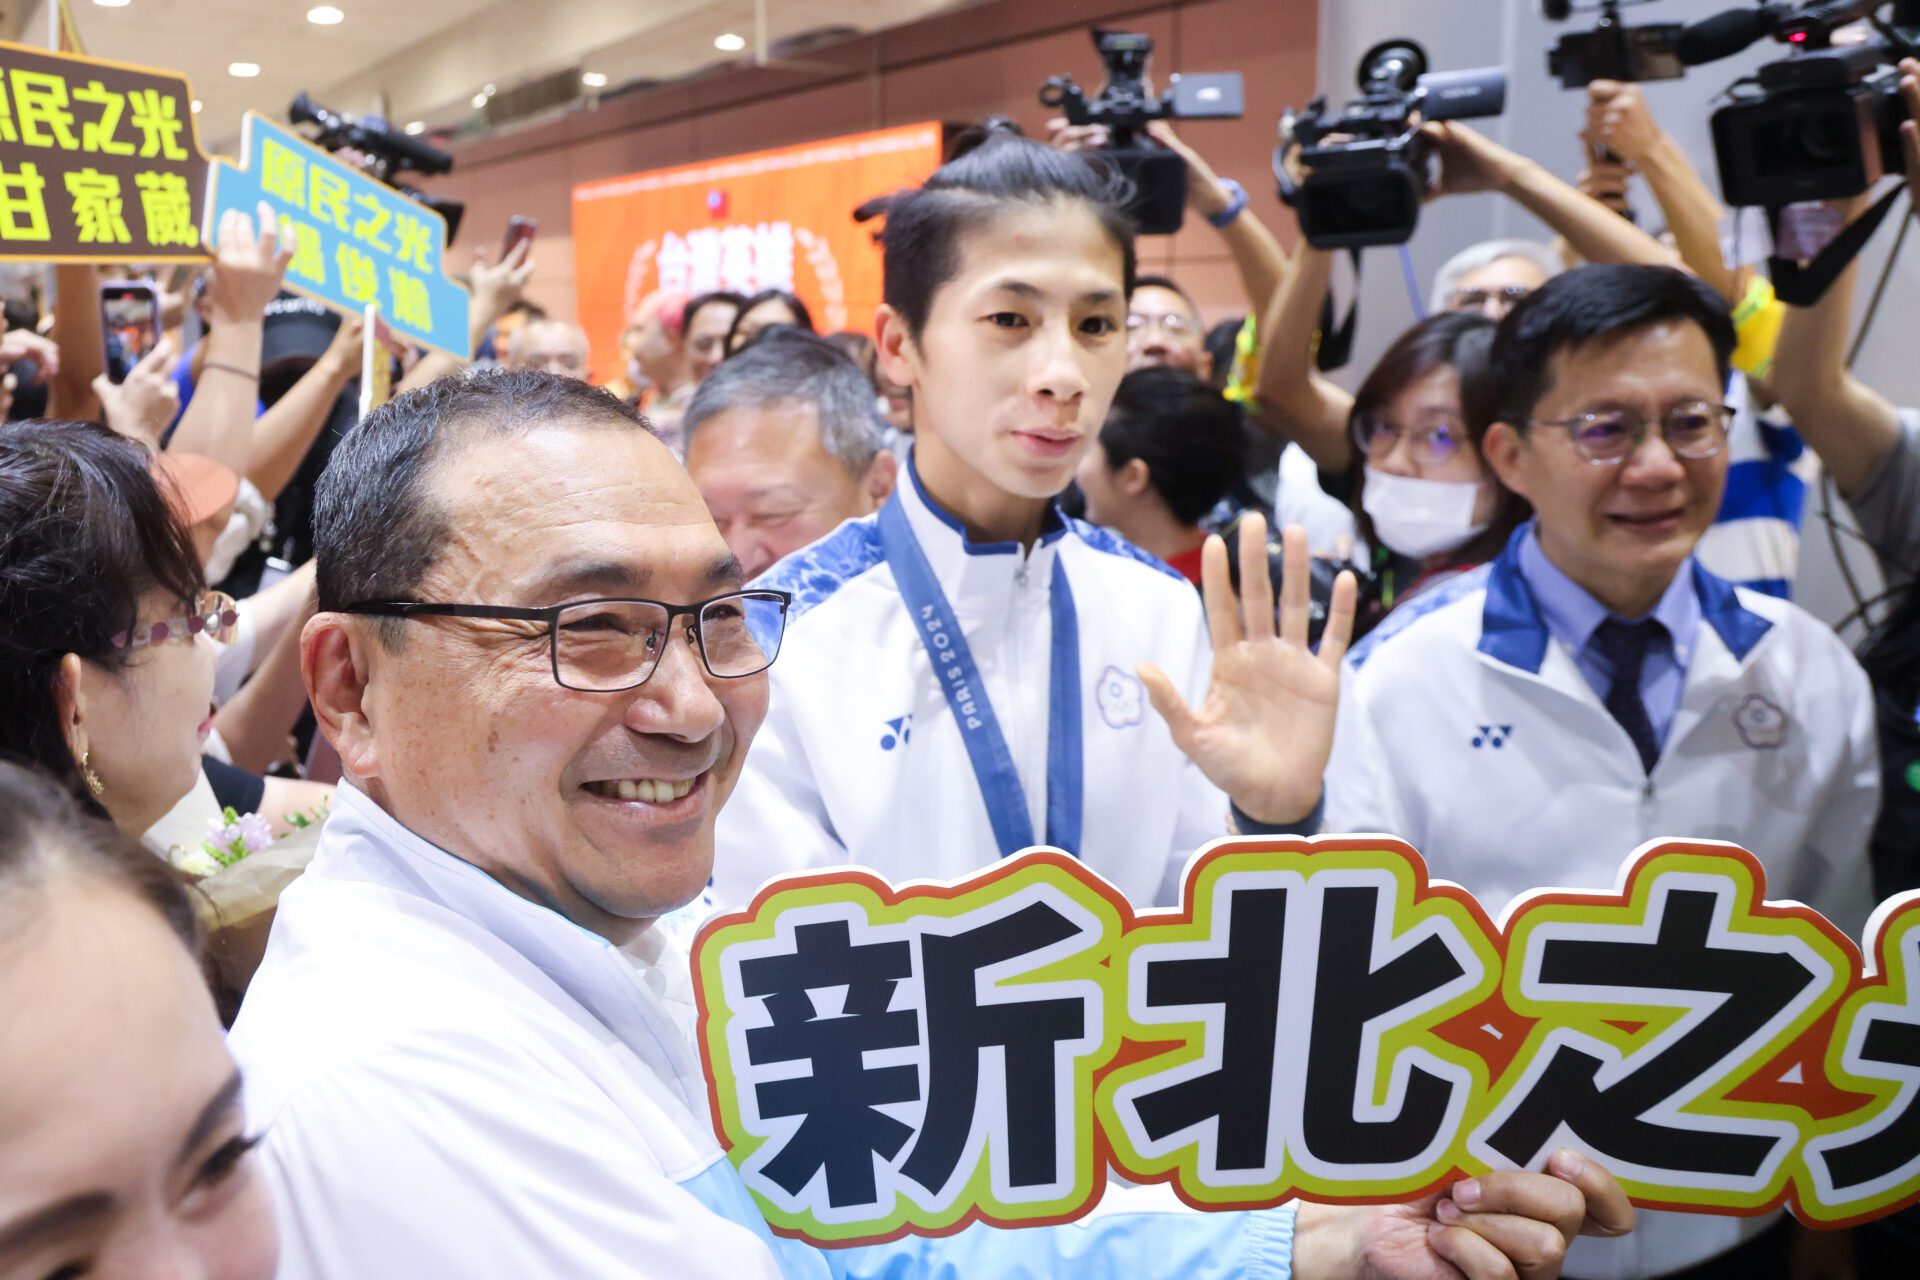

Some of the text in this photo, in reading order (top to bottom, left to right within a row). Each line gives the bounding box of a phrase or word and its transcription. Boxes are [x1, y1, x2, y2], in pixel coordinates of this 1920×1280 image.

[261, 137, 433, 274] 原民之光
[921, 603, 982, 730] PARIS 2024
[741, 885, 1920, 1207] 新北之
